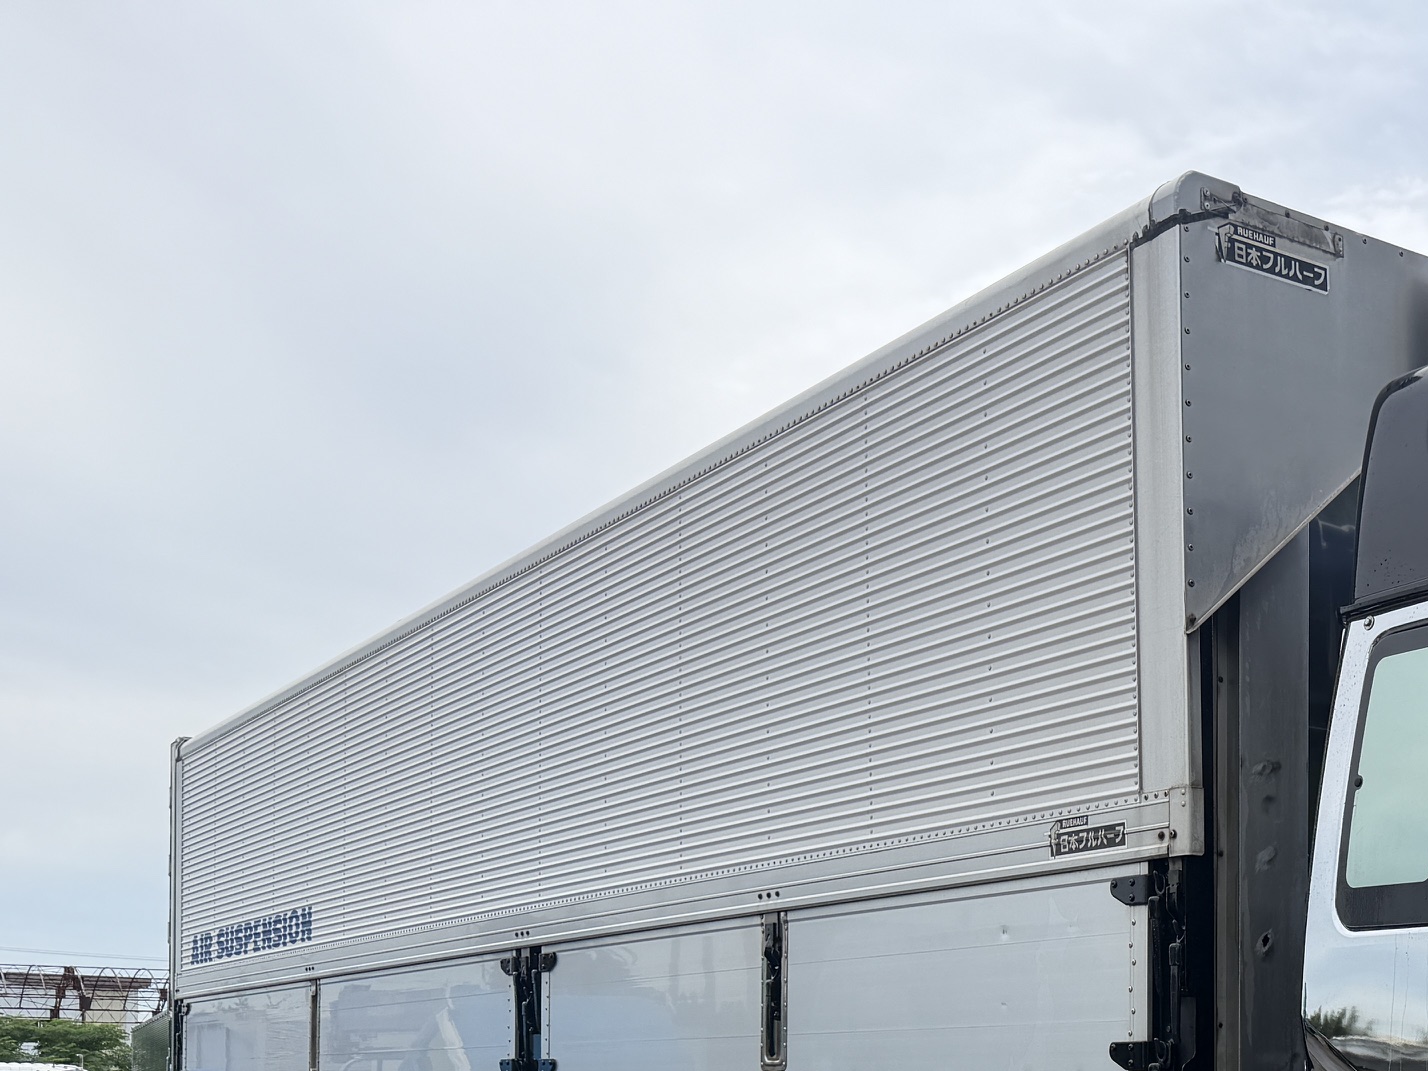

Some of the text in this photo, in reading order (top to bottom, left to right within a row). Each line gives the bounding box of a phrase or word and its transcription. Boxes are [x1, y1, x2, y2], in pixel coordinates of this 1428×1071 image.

[1234, 241, 1326, 286] 日本フルハーフ
[1060, 825, 1124, 853] 日本フルハーフ
[190, 906, 313, 965] AIR SUSPENSION
